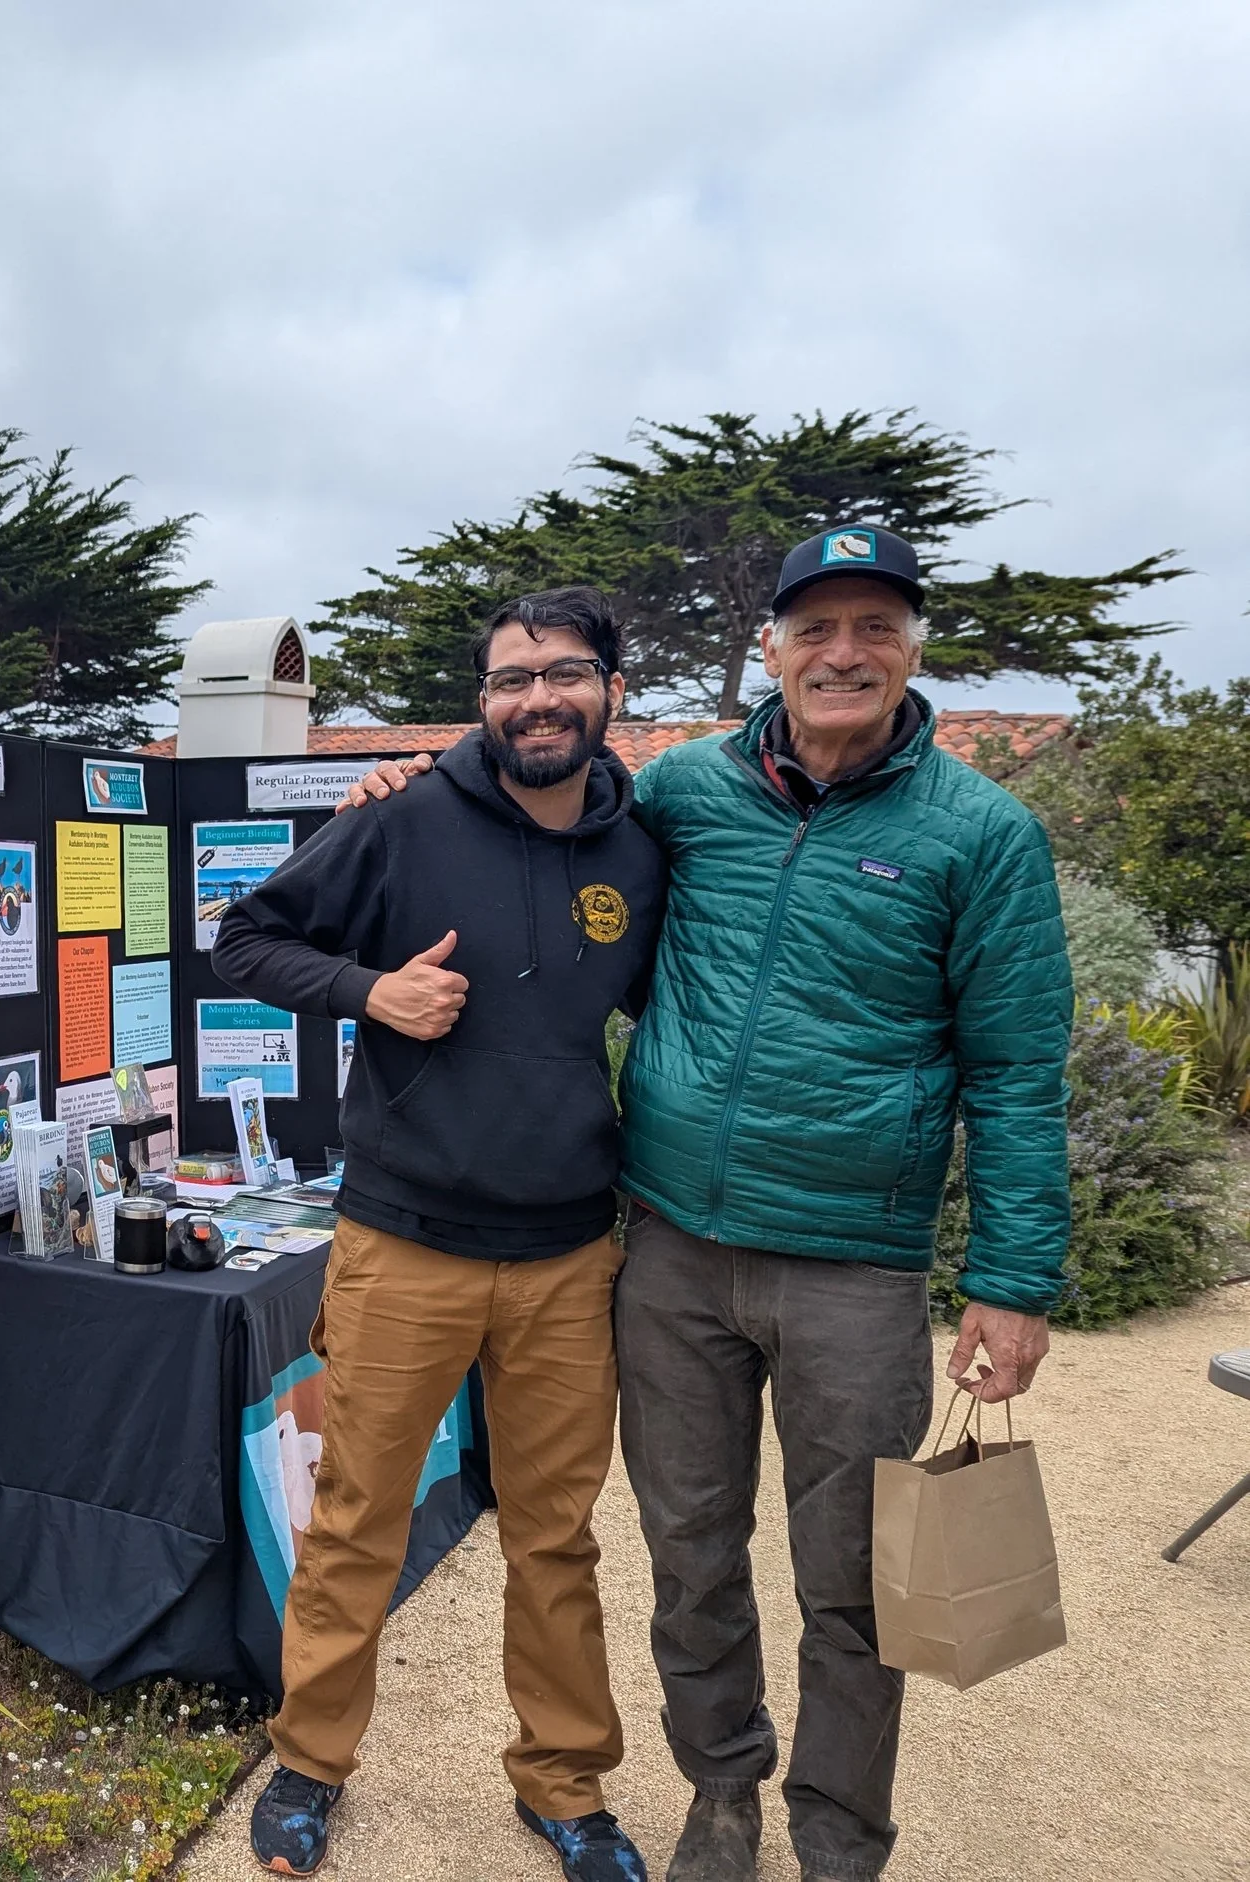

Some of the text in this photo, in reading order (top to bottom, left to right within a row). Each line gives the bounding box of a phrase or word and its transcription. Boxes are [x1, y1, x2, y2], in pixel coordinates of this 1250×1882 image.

[110, 773, 138, 782] MONTEREY
[255, 775, 300, 788] Regular
[303, 774, 359, 787] Programs
[111, 783, 139, 792] AUDUBON
[112, 793, 140, 804] SOCIETY
[282, 789, 345, 801] Field Trips
[206, 829, 281, 840] Beginner Birding
[862, 865, 895, 880] patagonia
[81, 947, 94, 956] Chapter
[208, 1005, 247, 1015] Monthly
[160, 1082, 174, 1090] Society
[39, 1129, 65, 1142] BIRDING
[90, 1139, 110, 1149] AUDUBON
[91, 1145, 111, 1157] SOCIETY
